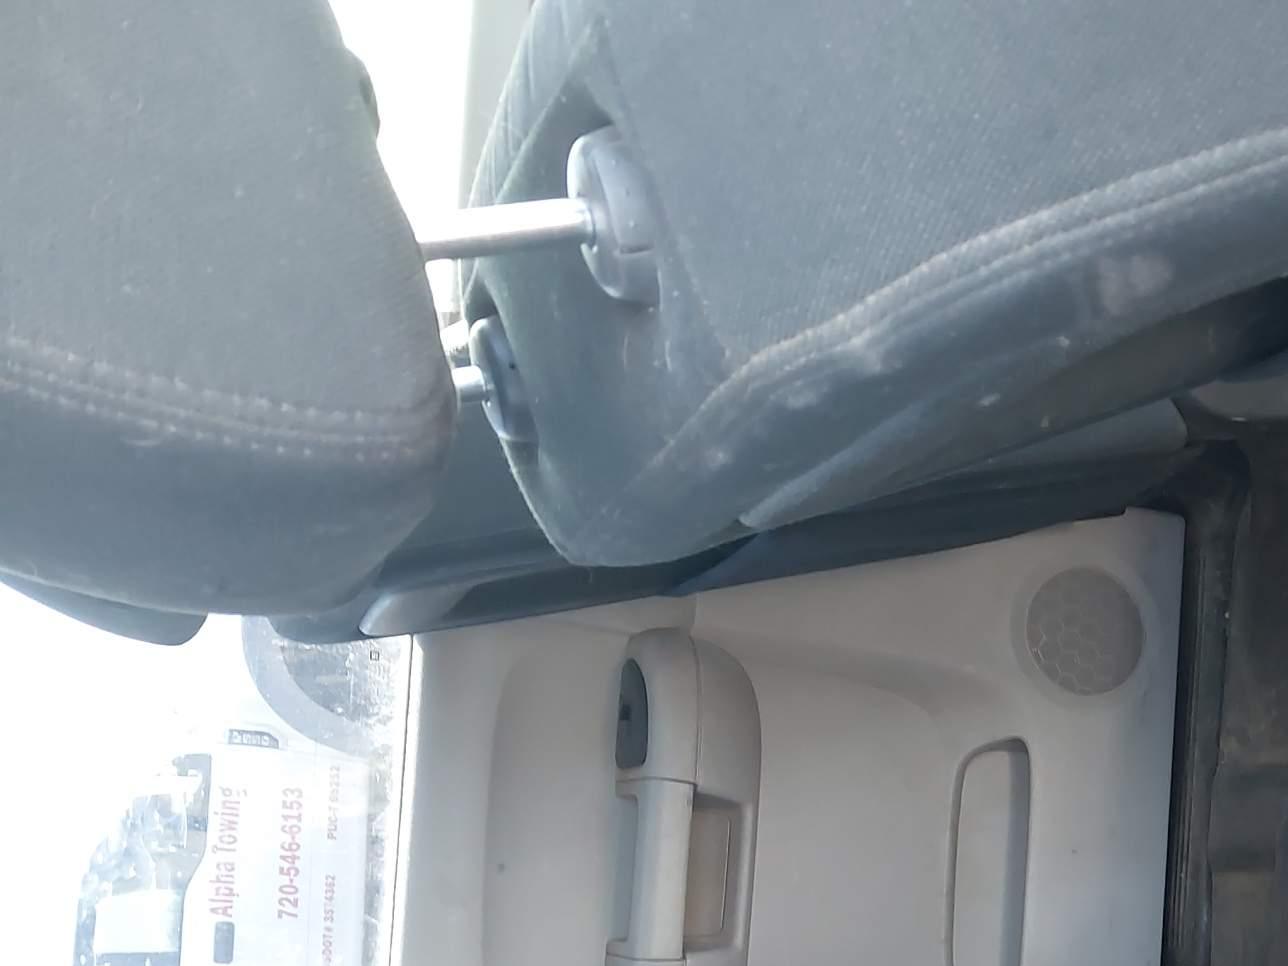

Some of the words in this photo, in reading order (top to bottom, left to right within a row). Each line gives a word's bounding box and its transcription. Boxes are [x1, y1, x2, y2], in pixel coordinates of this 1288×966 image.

[211, 786, 248, 854] Towing
[277, 787, 303, 920] 720-546-6153
[208, 862, 239, 918] Alpha
